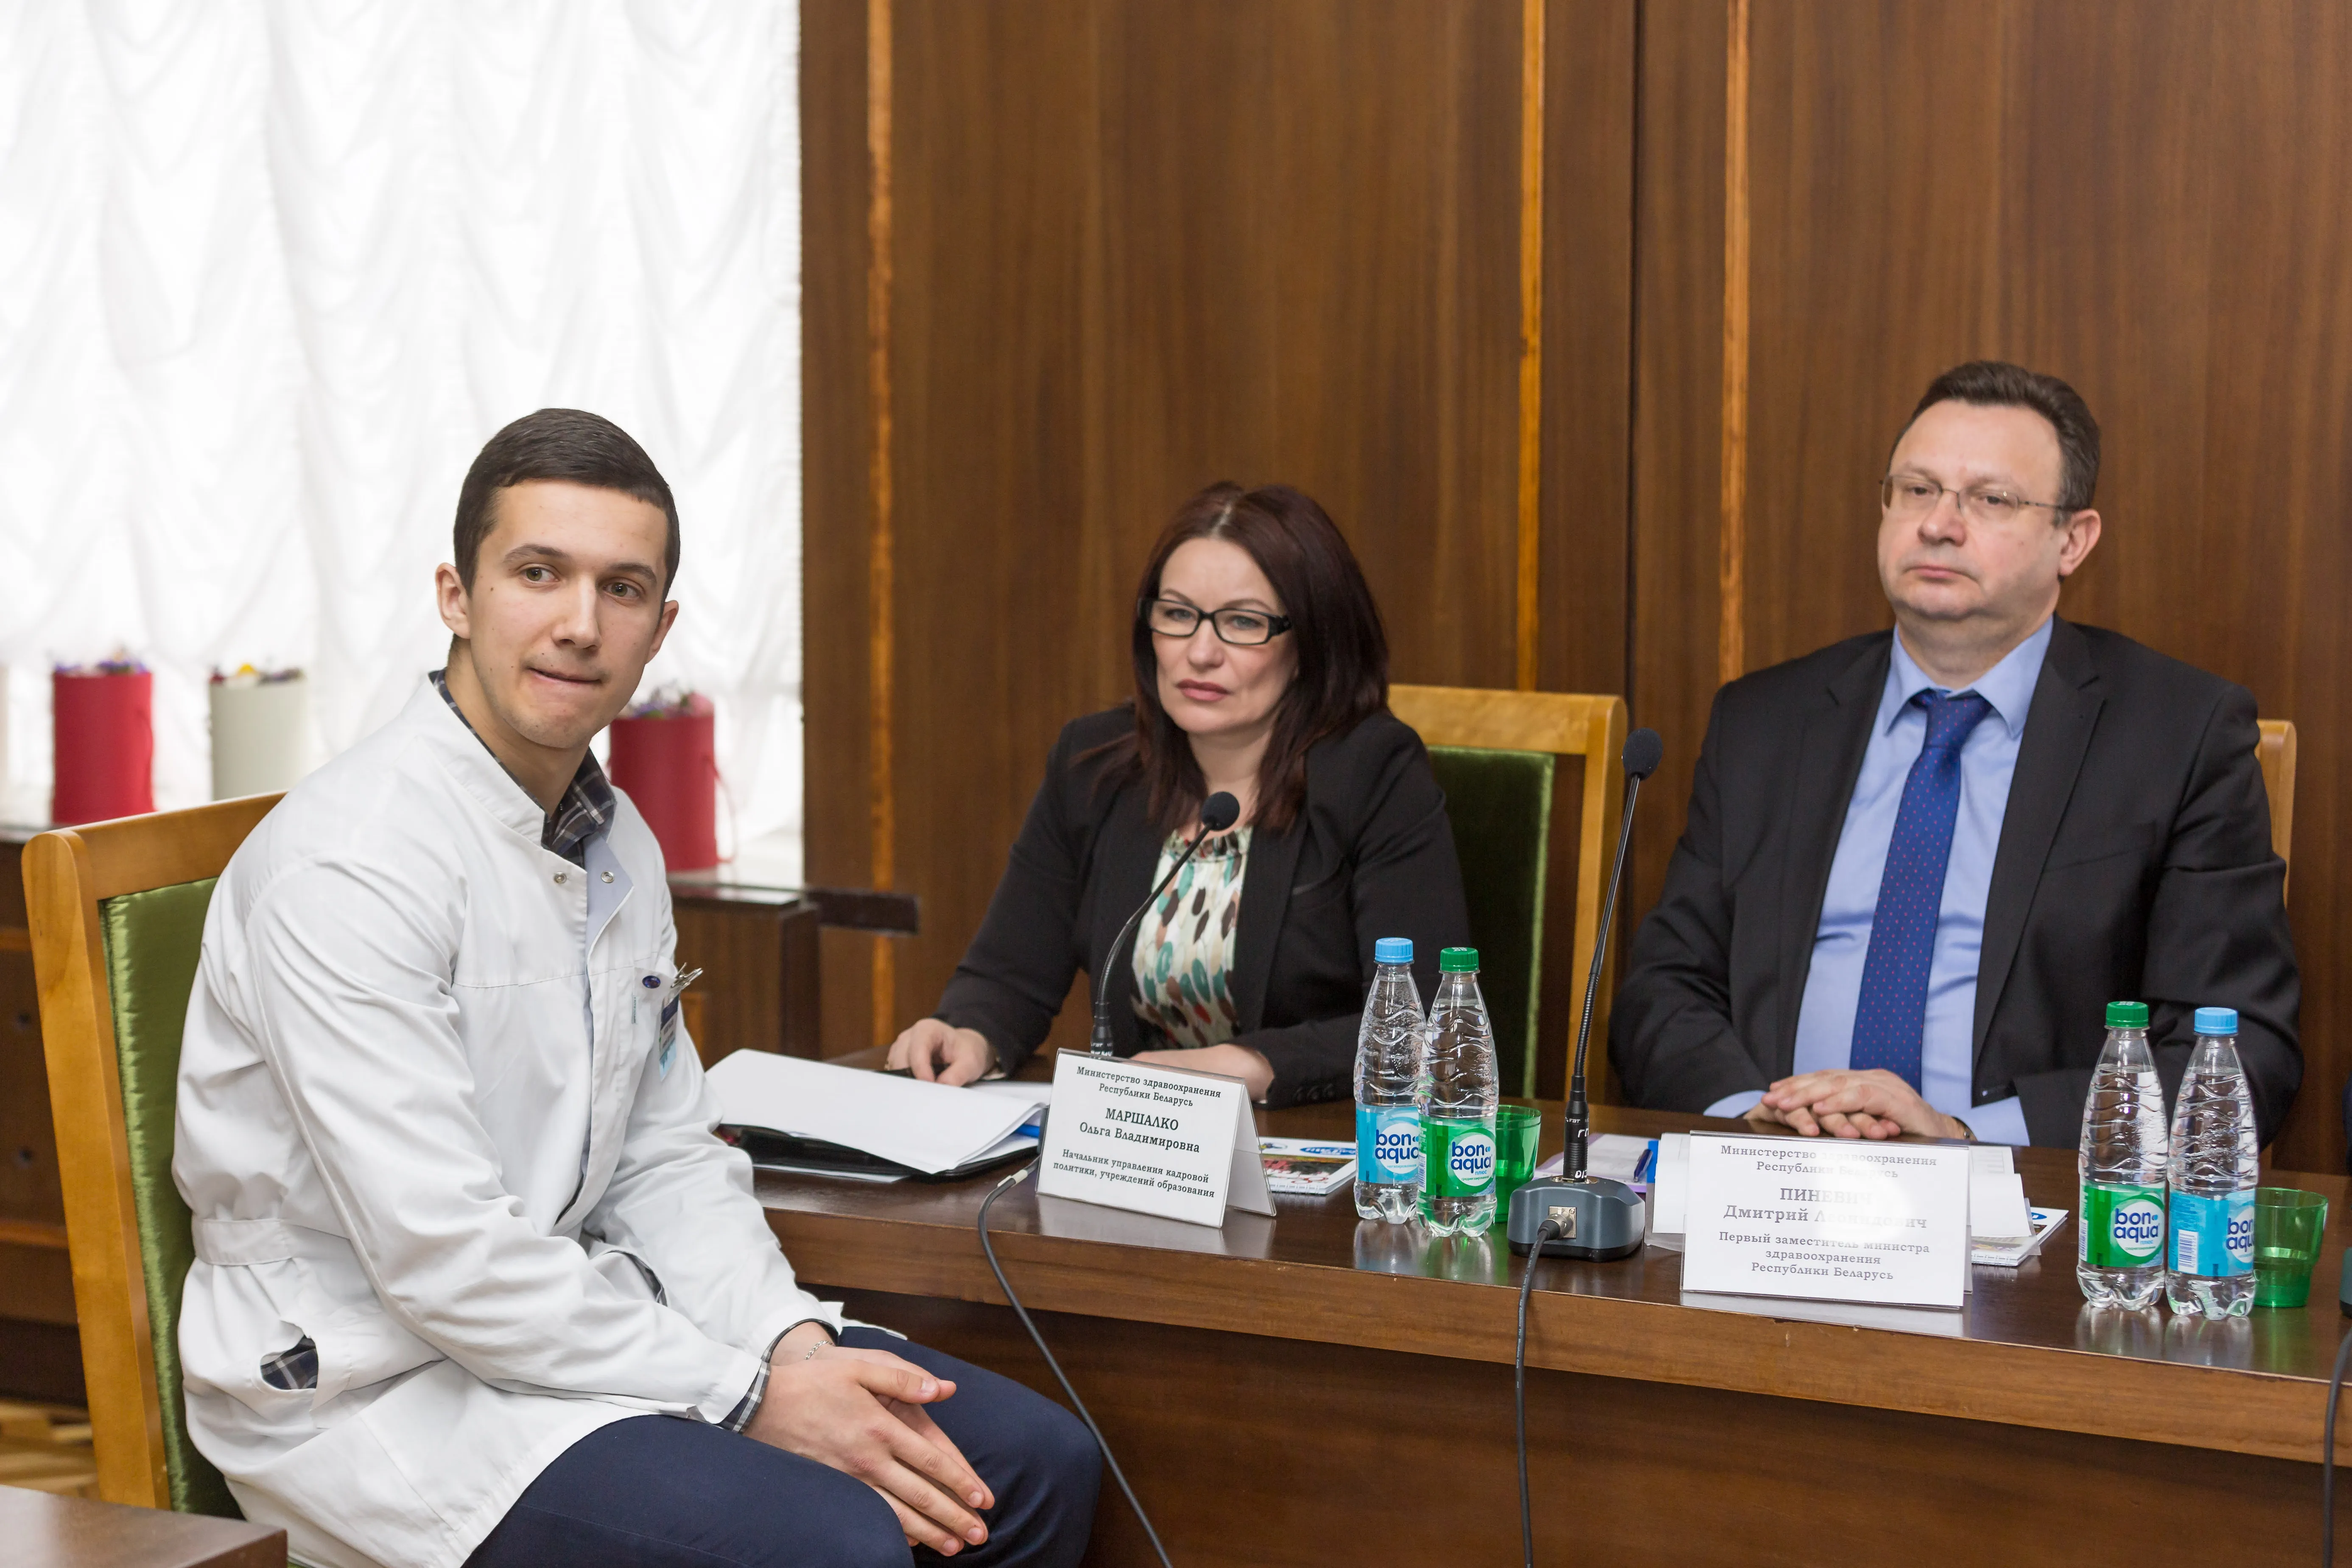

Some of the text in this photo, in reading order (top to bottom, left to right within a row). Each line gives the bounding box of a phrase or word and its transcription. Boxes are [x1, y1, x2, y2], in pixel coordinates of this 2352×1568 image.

[1077, 1066, 1221, 1098] Министерство здравоохранения
[1099, 1083, 1193, 1107] Республики Беларусь
[1105, 1108, 1179, 1131] МАРШАЛКО
[1080, 1122, 1200, 1153] Ольга Владимировна
[1376, 1129, 1411, 1146] bon
[1375, 1147, 1418, 1164] aqua
[1452, 1141, 1485, 1157] bon
[1720, 1145, 1816, 1160] Министерство
[1062, 1149, 1209, 1183] Начальник управления кадровой
[1451, 1156, 1491, 1174] aqua
[1756, 1161, 1834, 1174] Республики
[1053, 1163, 1215, 1198] политики, учреждений образования
[1779, 1188, 1872, 1205] ПИНЕВИЧ
[1723, 1205, 1809, 1223] Дмитрий
[2114, 1208, 2151, 1225] bon
[1719, 1231, 1930, 1255] Первый заместитель министра
[2113, 1225, 2158, 1243] aqua
[2226, 1234, 2253, 1252] aqu
[1765, 1251, 1881, 1264] здравоохранения
[1751, 1262, 1893, 1280] Республики Беларусь
